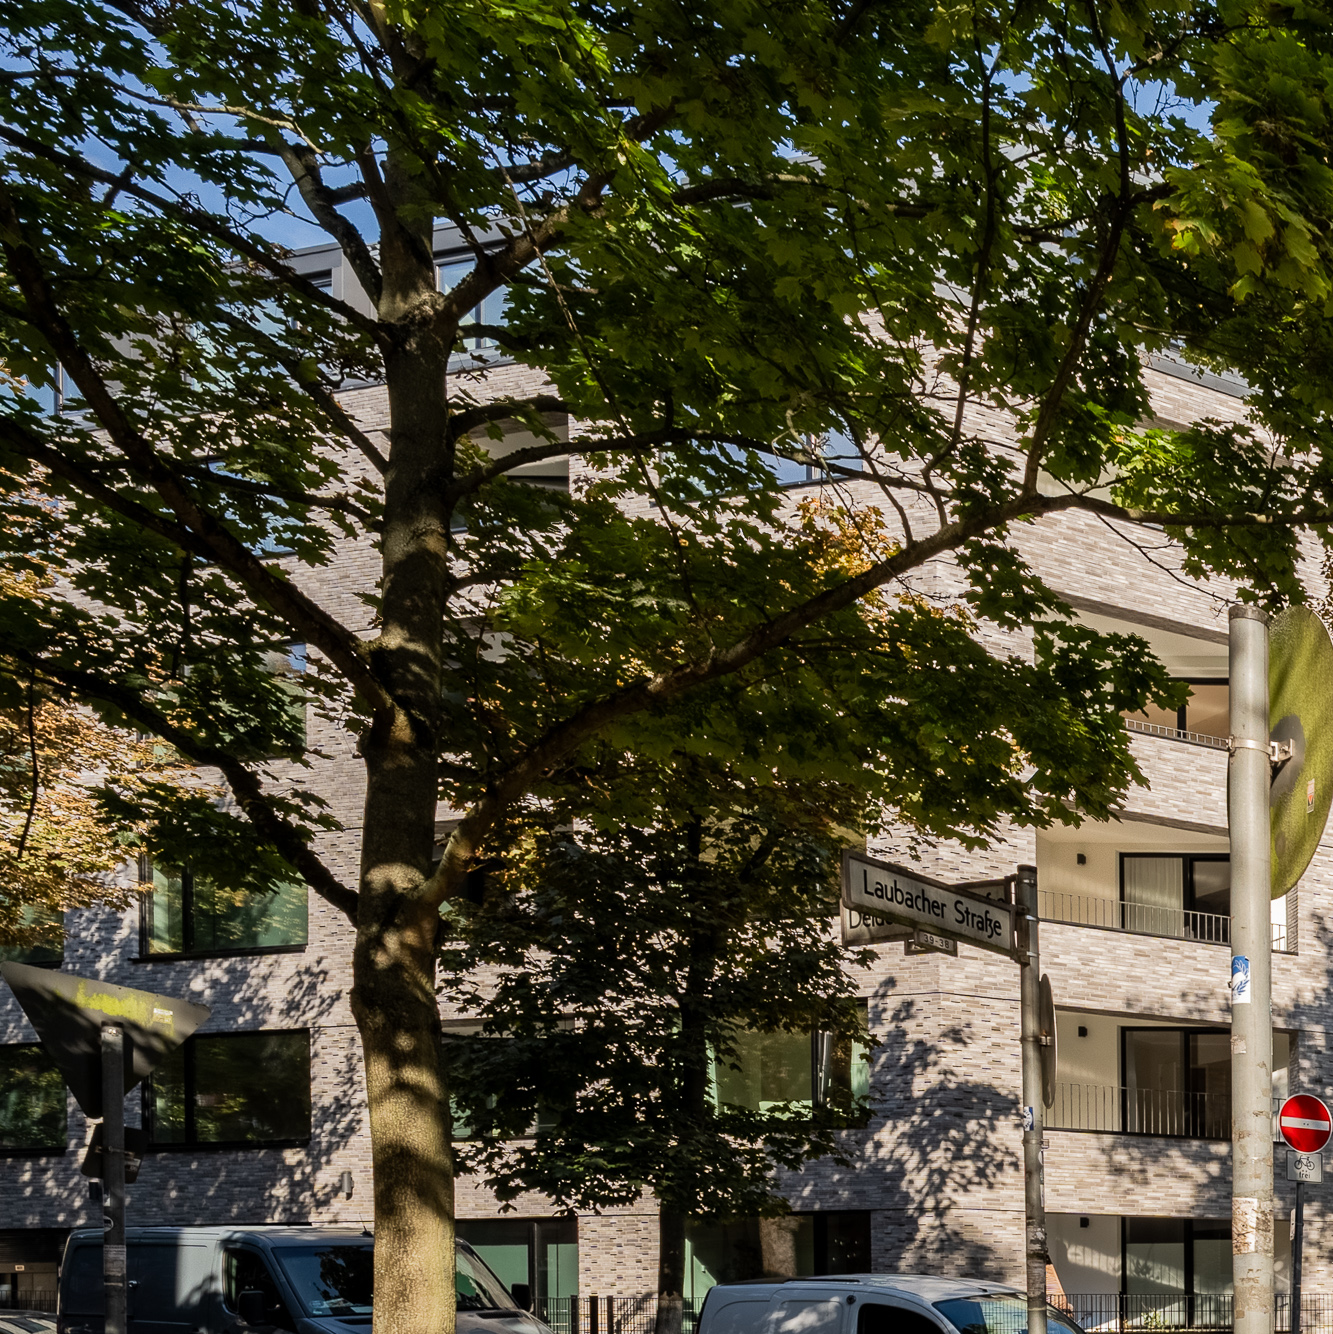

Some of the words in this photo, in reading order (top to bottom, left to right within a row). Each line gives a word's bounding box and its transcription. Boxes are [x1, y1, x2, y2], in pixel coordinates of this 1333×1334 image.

[863, 869, 946, 919] Laubacher
[954, 900, 1002, 939] Straße
[923, 934, 950, 949] 39-38
[1299, 1170, 1310, 1179] frei
